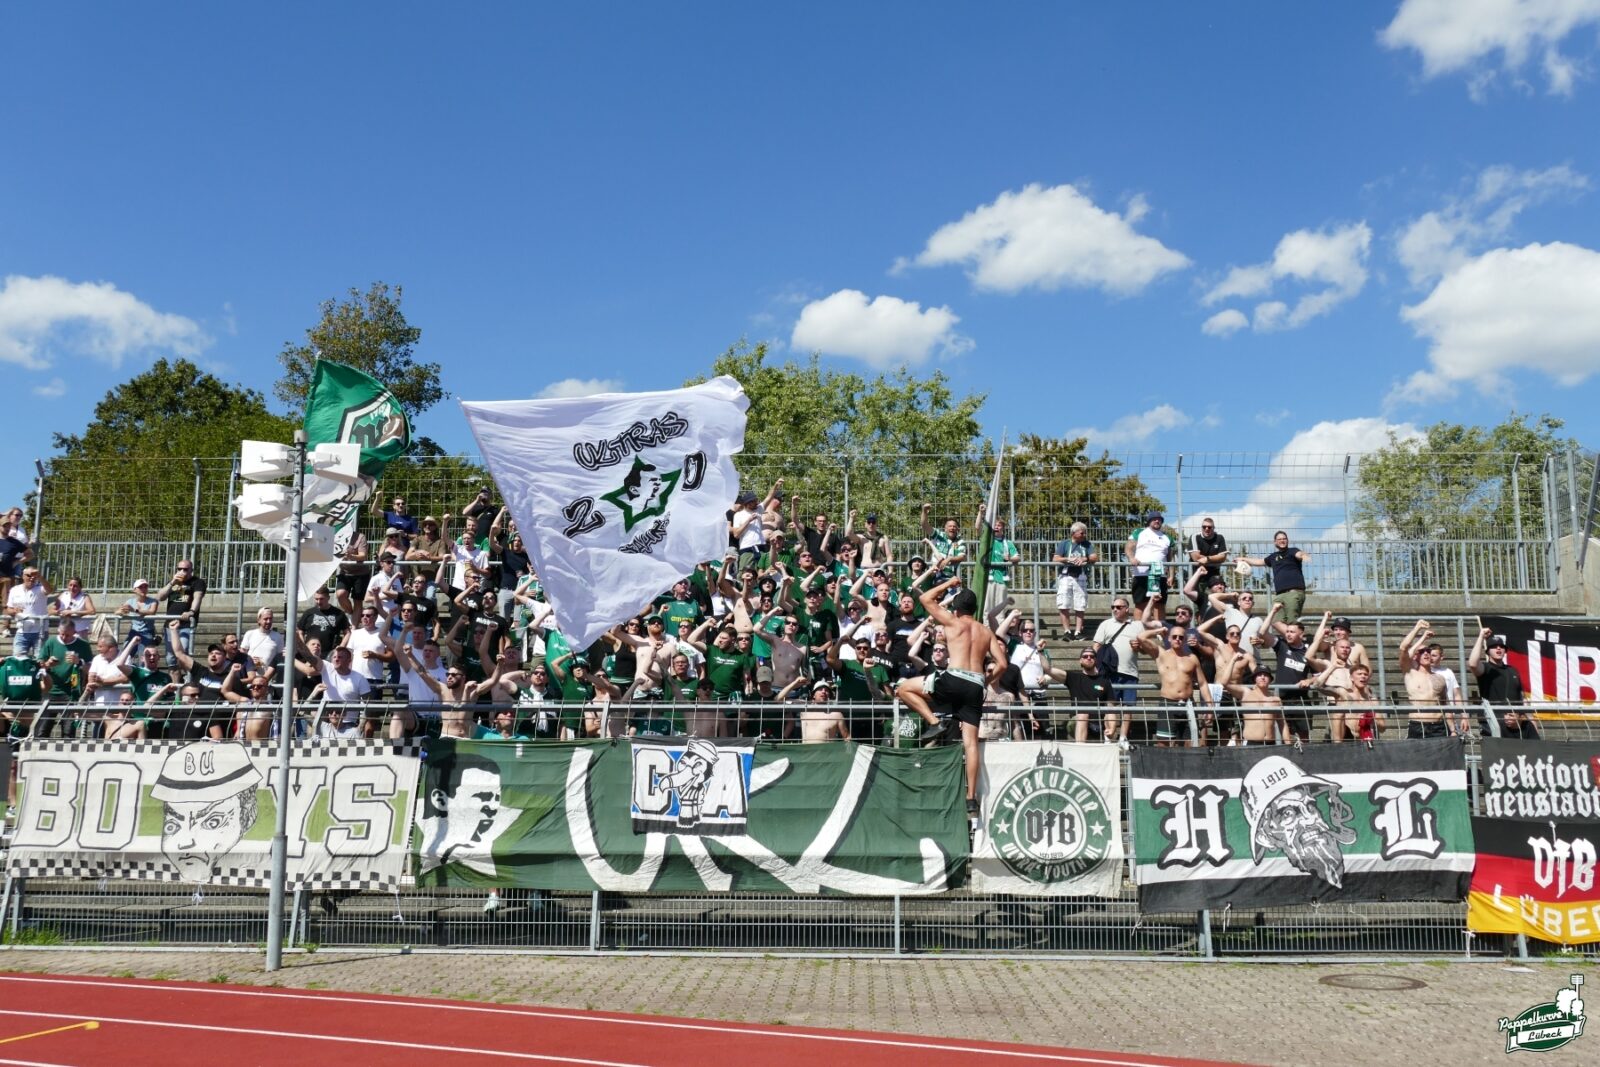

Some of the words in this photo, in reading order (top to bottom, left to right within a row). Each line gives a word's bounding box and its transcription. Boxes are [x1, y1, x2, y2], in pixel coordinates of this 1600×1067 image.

[573, 412, 689, 471] ULTRAS
[184, 750, 215, 776] BU
[1002, 769, 1099, 813] SUBKULTUR
[1260, 767, 1289, 790] 1919
[1044, 856, 1088, 880] YOUTH
